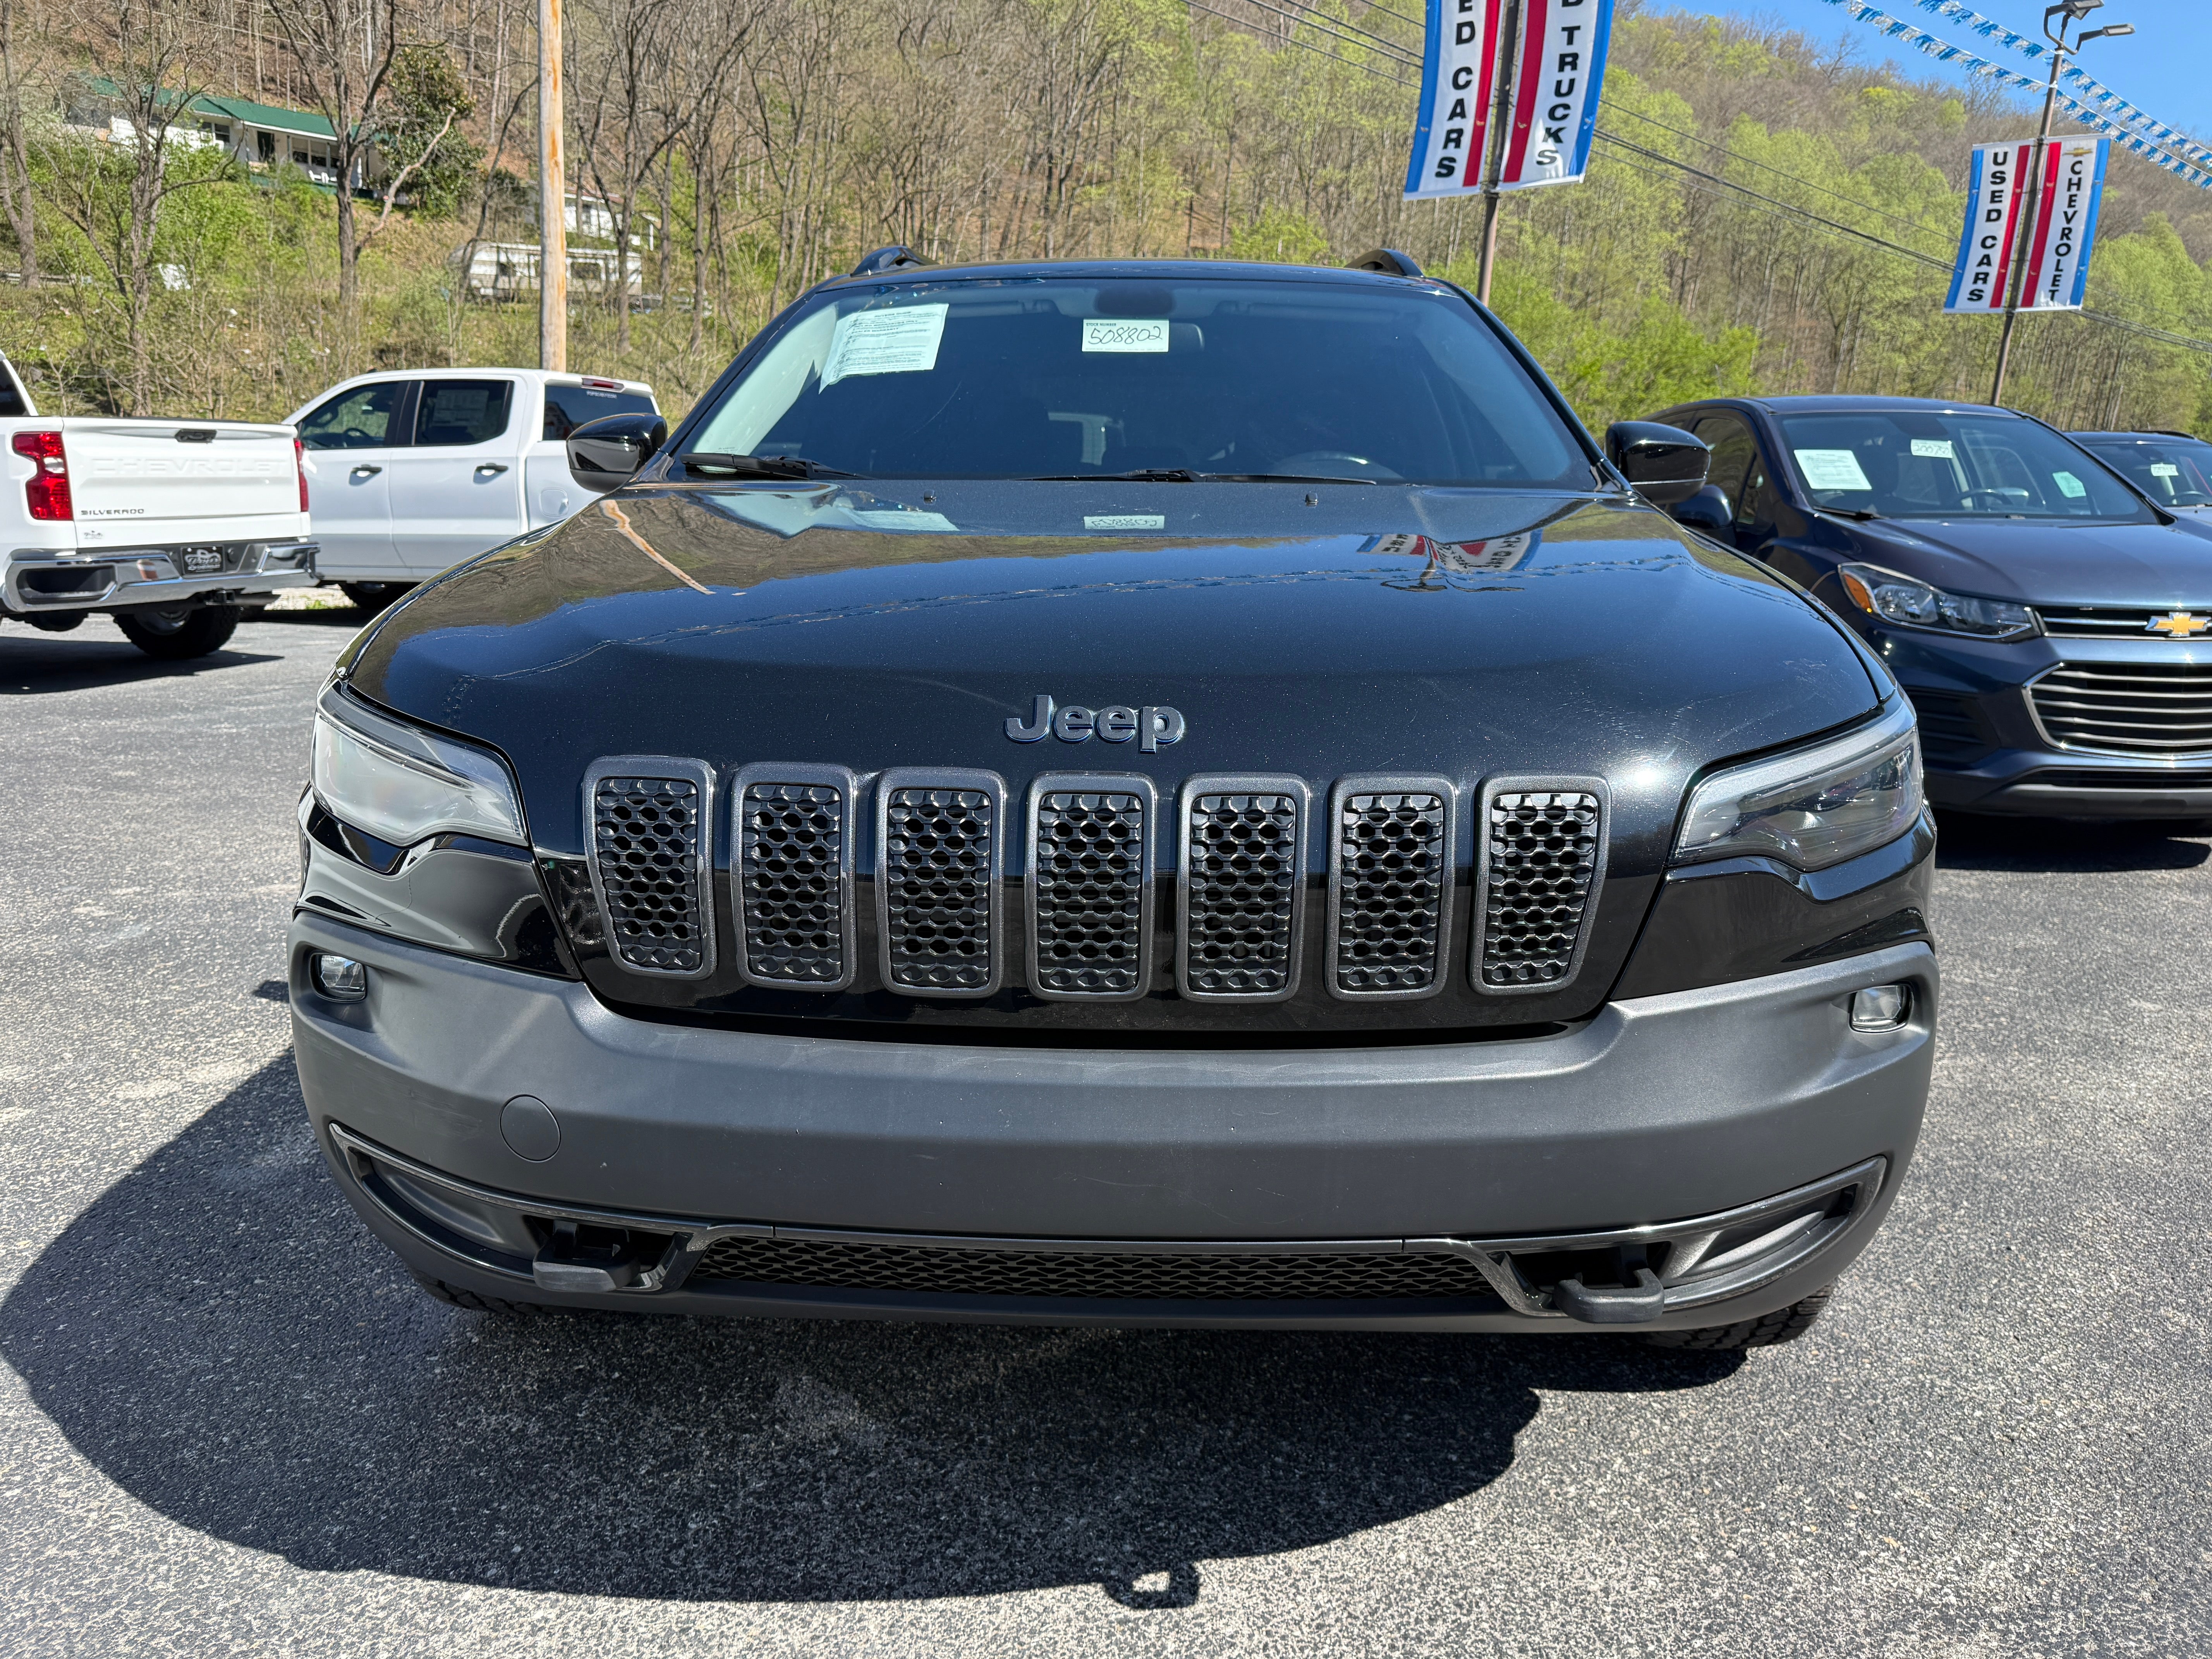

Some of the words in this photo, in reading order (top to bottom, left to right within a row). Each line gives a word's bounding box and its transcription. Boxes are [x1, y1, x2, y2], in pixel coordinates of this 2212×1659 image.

[1435, 67, 1472, 178] CARS
[1536, 25, 1581, 166] TRUCKS
[1985, 151, 2008, 222] USED
[2049, 160, 2083, 302] CHEVROLET
[1967, 235, 1997, 302] CARS
[1088, 326, 1163, 344] 508802
[91, 458, 286, 474] CHEVROLET
[1004, 694, 1184, 754] Jeep
